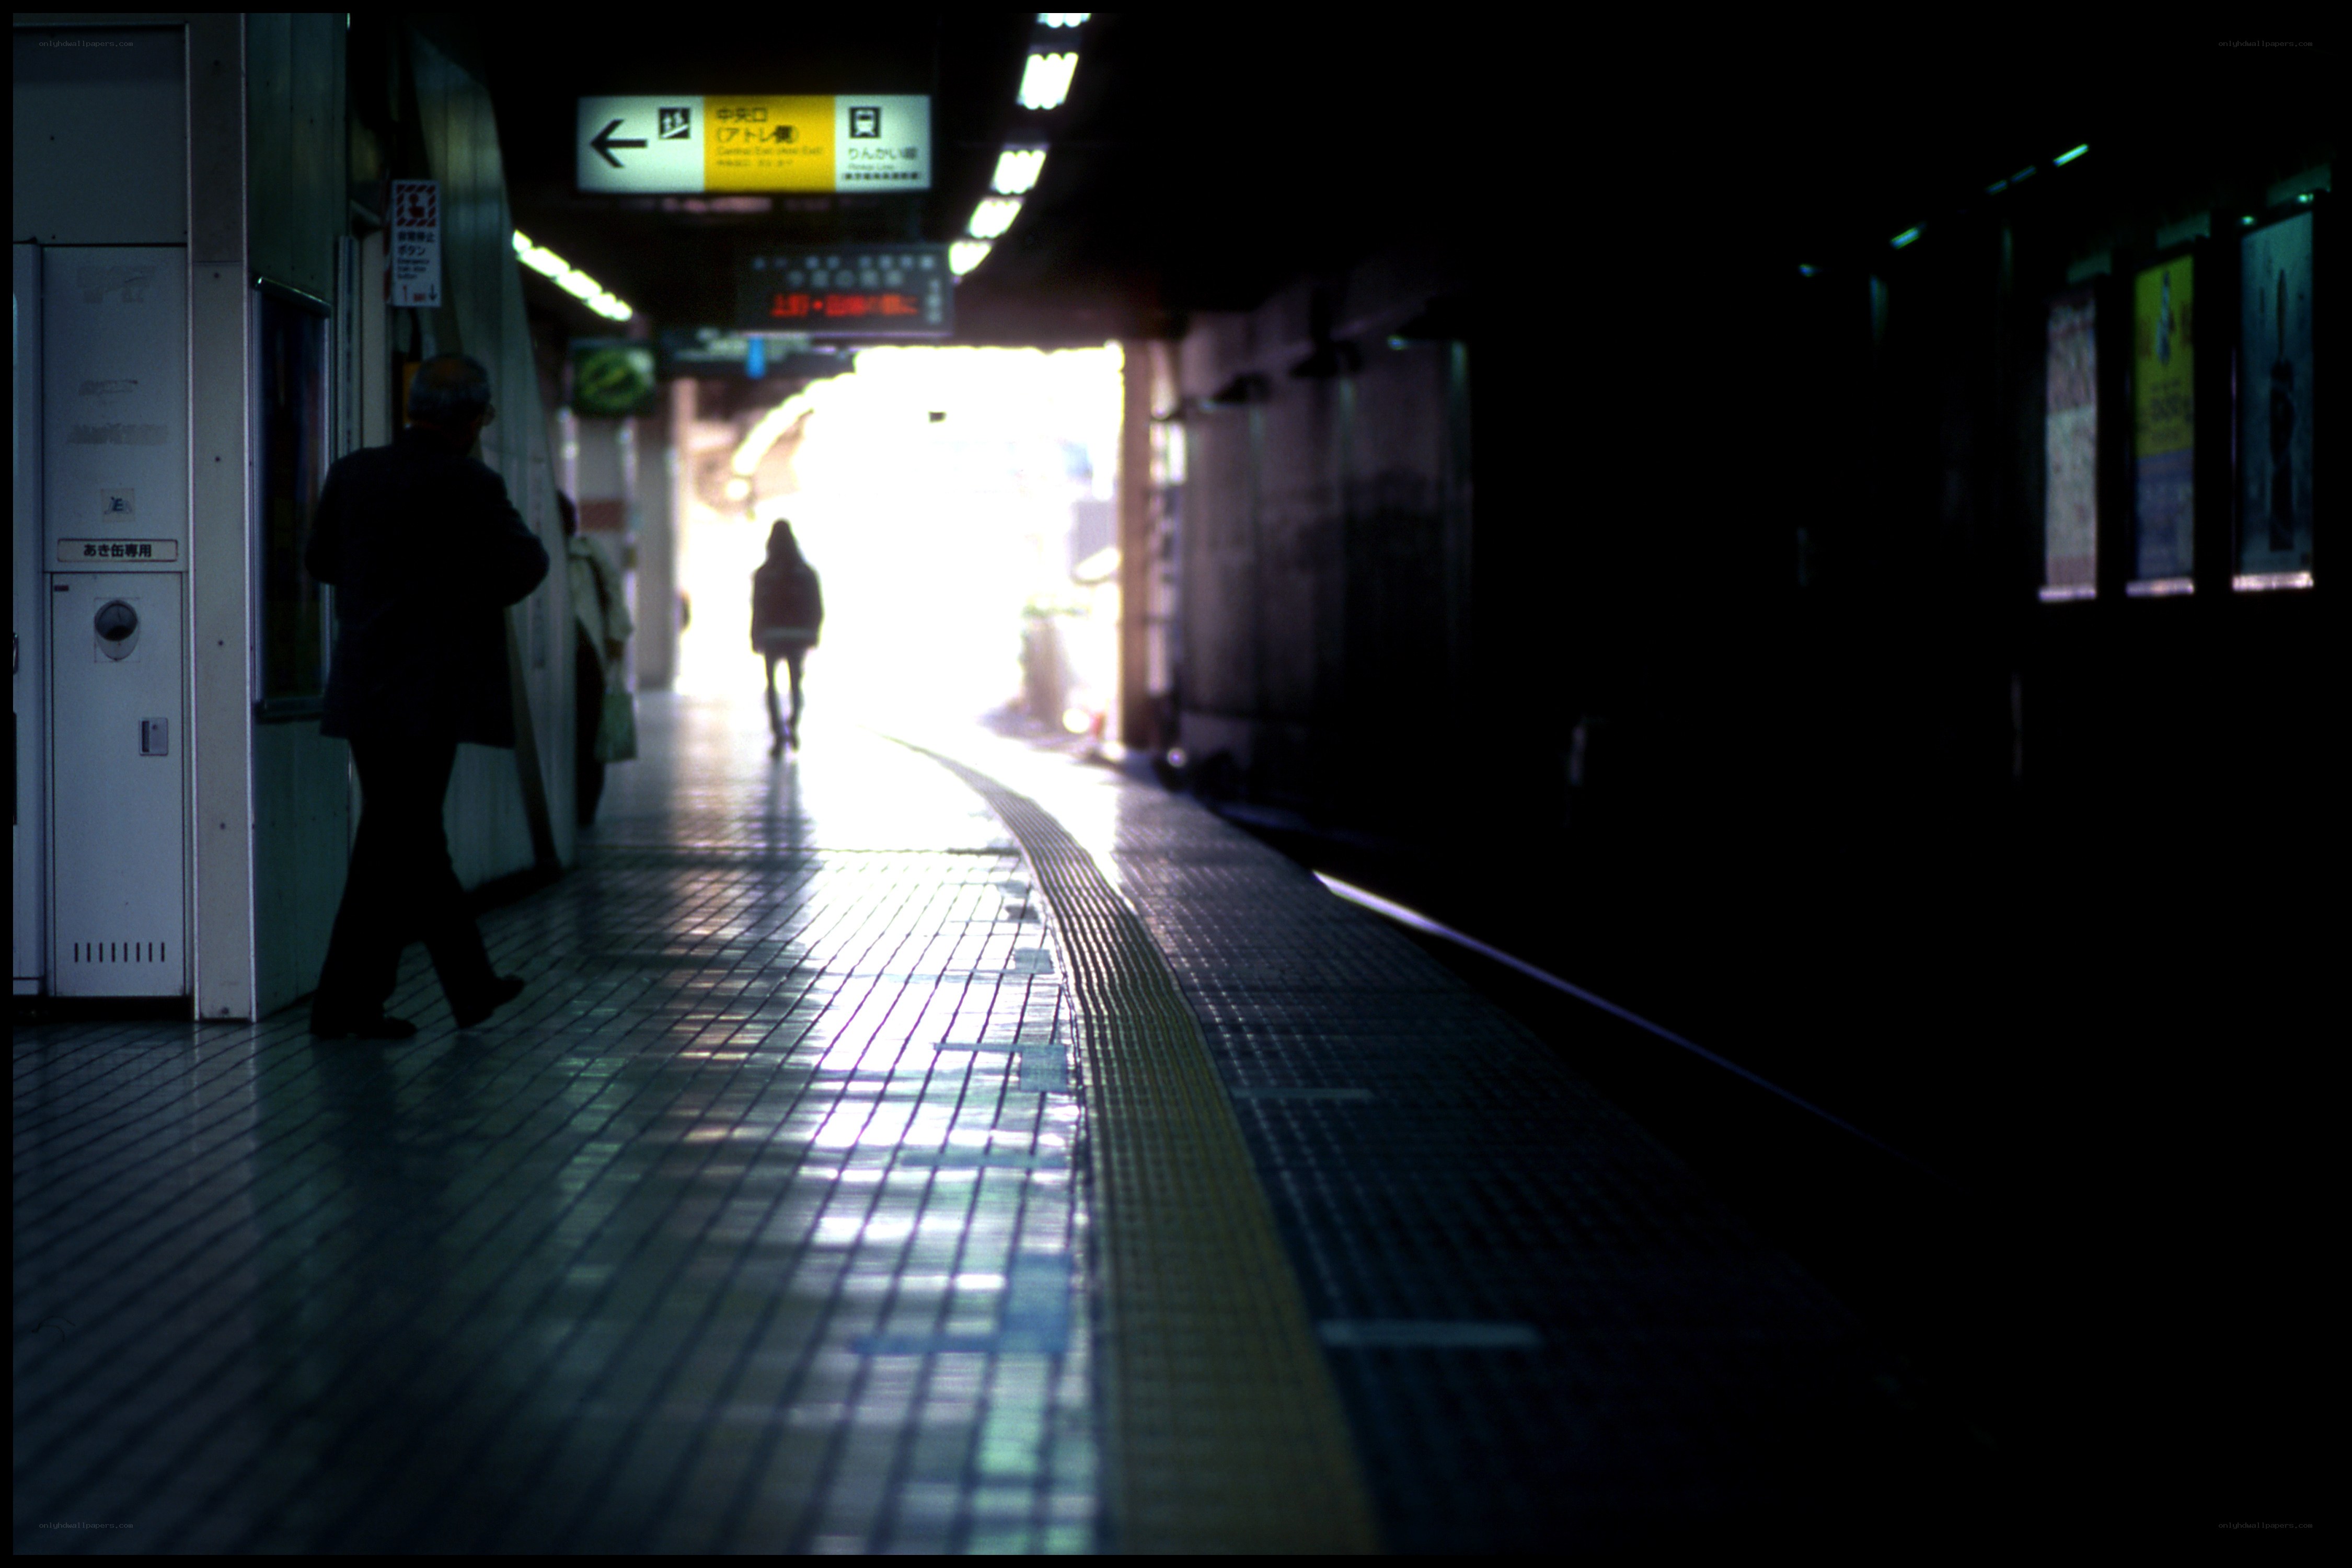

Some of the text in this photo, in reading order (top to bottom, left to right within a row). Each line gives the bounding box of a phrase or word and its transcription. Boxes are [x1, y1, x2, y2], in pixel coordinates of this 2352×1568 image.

[717, 107, 767, 123] 中央口
[84, 544, 152, 557] あき缶専用
